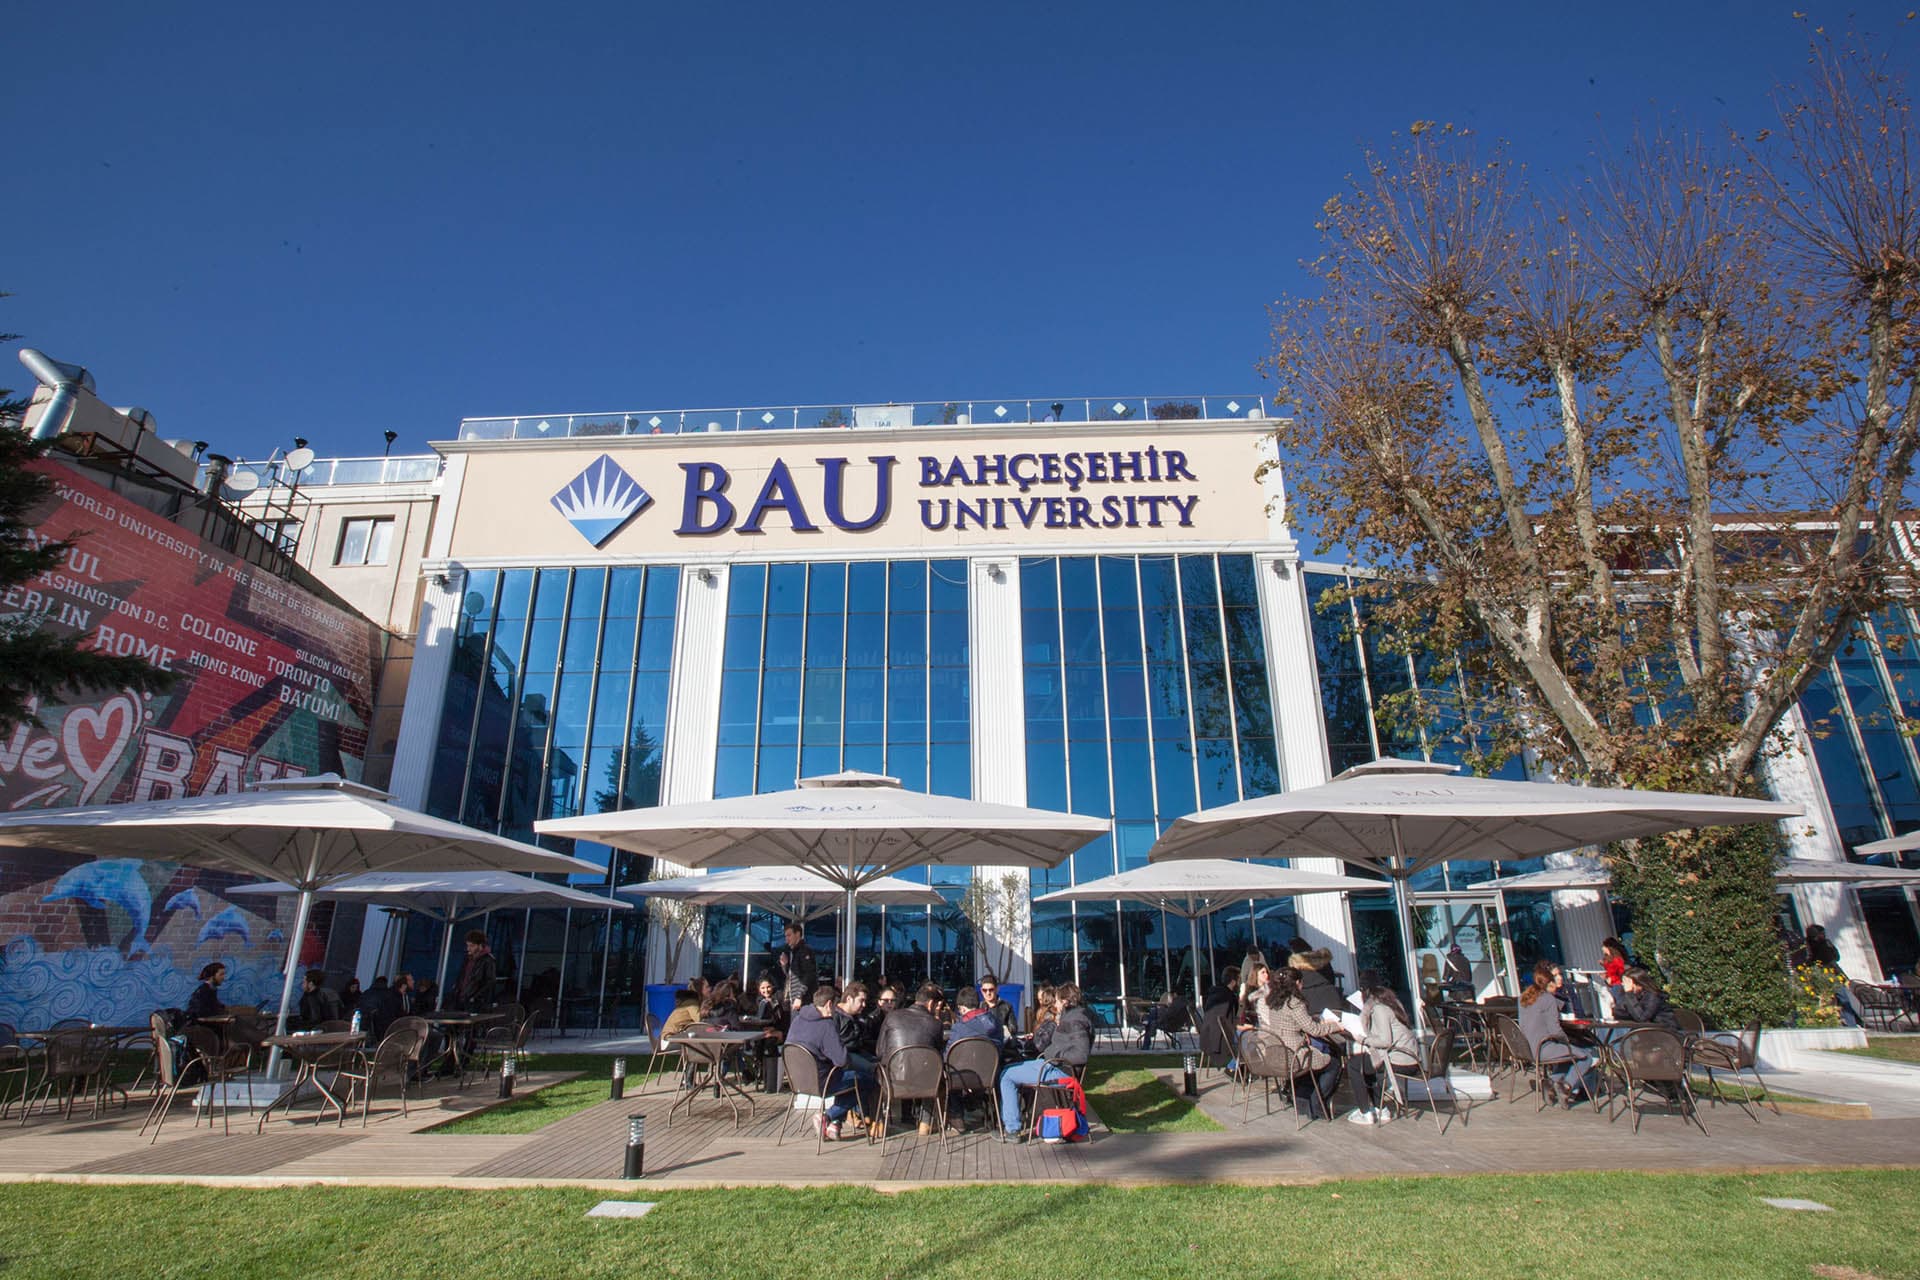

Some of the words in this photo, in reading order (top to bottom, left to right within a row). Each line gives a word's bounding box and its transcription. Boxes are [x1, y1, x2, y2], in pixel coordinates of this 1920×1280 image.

[918, 443, 1197, 491] BAHÇEŞEHİR
[673, 456, 897, 537] BAU
[919, 494, 1200, 532] UNIVERSITY
[54, 481, 116, 521] WORLD
[119, 513, 208, 564] UNIVERSITY
[210, 556, 225, 573] IN
[226, 565, 250, 586] THE
[250, 580, 287, 604] HEART
[287, 597, 301, 610] OF
[301, 603, 347, 633] ISTANBUL
[0, 584, 91, 631] ERLIN
[32, 570, 142, 620] ASHINGTON
[144, 609, 170, 631] D.C.
[94, 624, 177, 673] ROME
[180, 613, 259, 658] COLOGNE
[188, 650, 229, 675] HONG
[229, 664, 266, 689] KONG
[267, 655, 330, 693] TORONTO
[295, 649, 330, 670] SILICON
[279, 684, 341, 721] BATUMI
